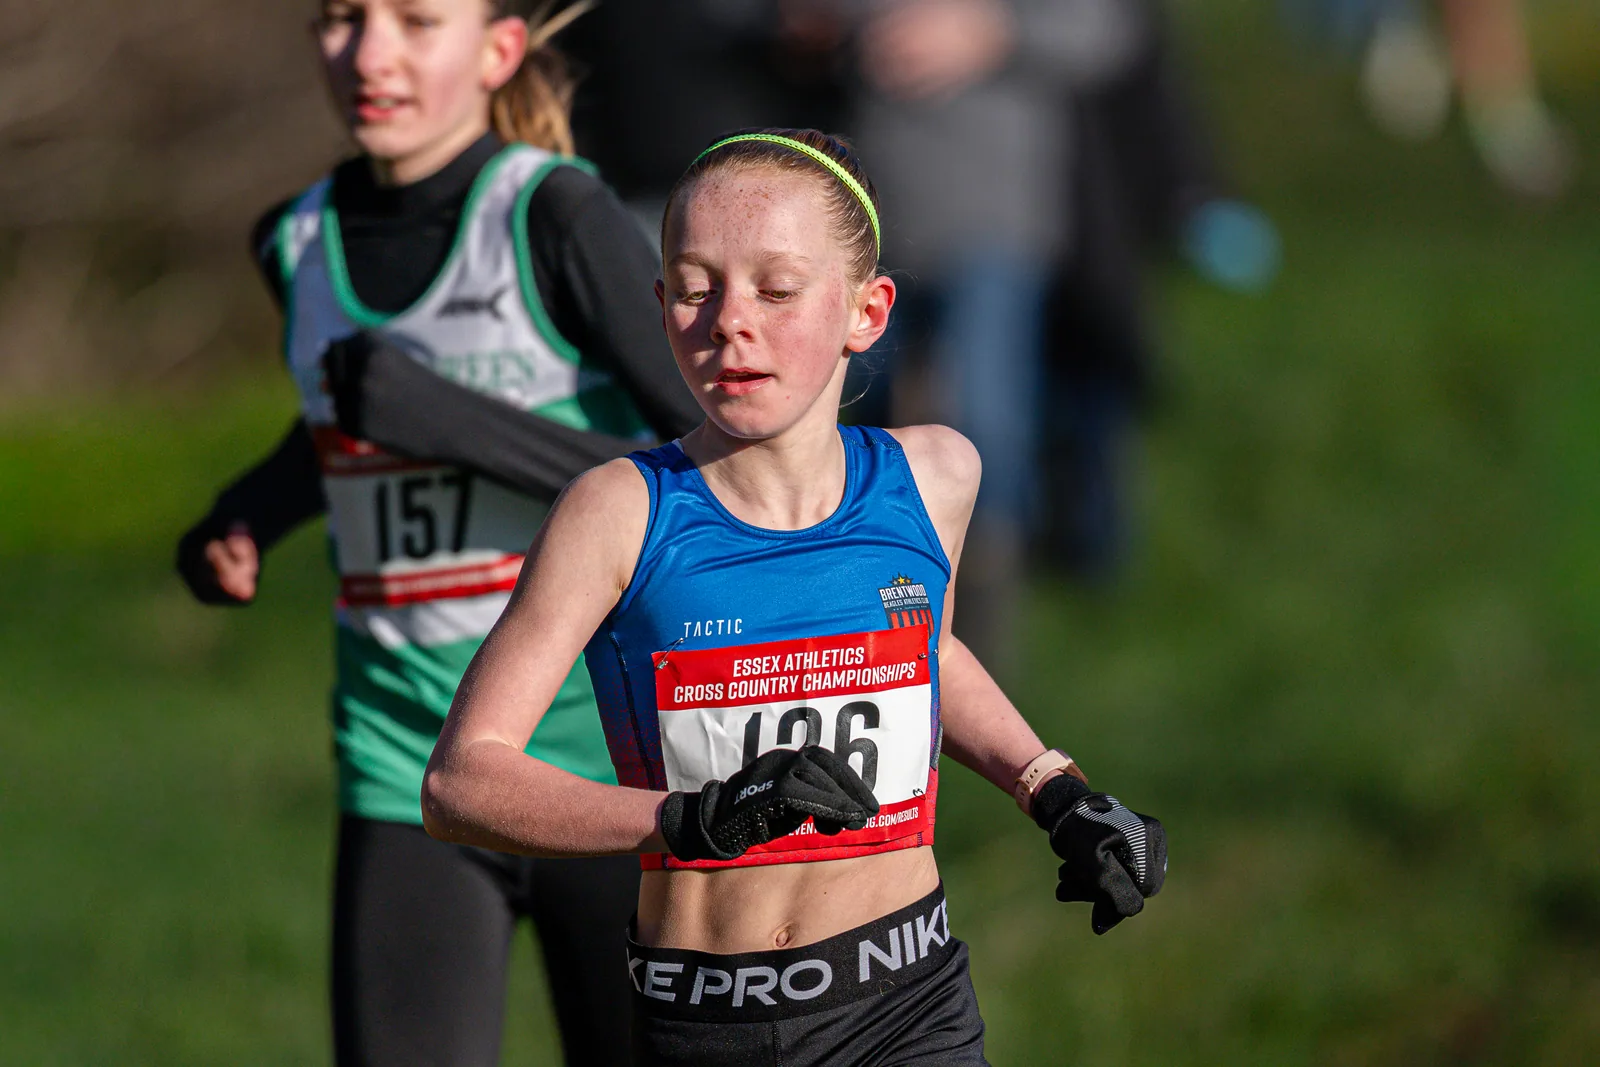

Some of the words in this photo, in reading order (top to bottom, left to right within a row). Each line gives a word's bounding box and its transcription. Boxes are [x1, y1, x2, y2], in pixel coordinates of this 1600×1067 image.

[375, 470, 472, 562] 157
[879, 584, 927, 601] BRENTWOOD
[883, 600, 903, 609] BEAGLES
[684, 619, 743, 638] TACTIC
[733, 662, 780, 678] ESSEX
[784, 647, 865, 672] ATHLETICS
[674, 684, 724, 703] CROSS
[728, 677, 798, 699] COUNTRY
[802, 661, 917, 693] CHAMPIONSHIPS
[734, 780, 774, 805] SPORT
[689, 959, 833, 1007] PRO
